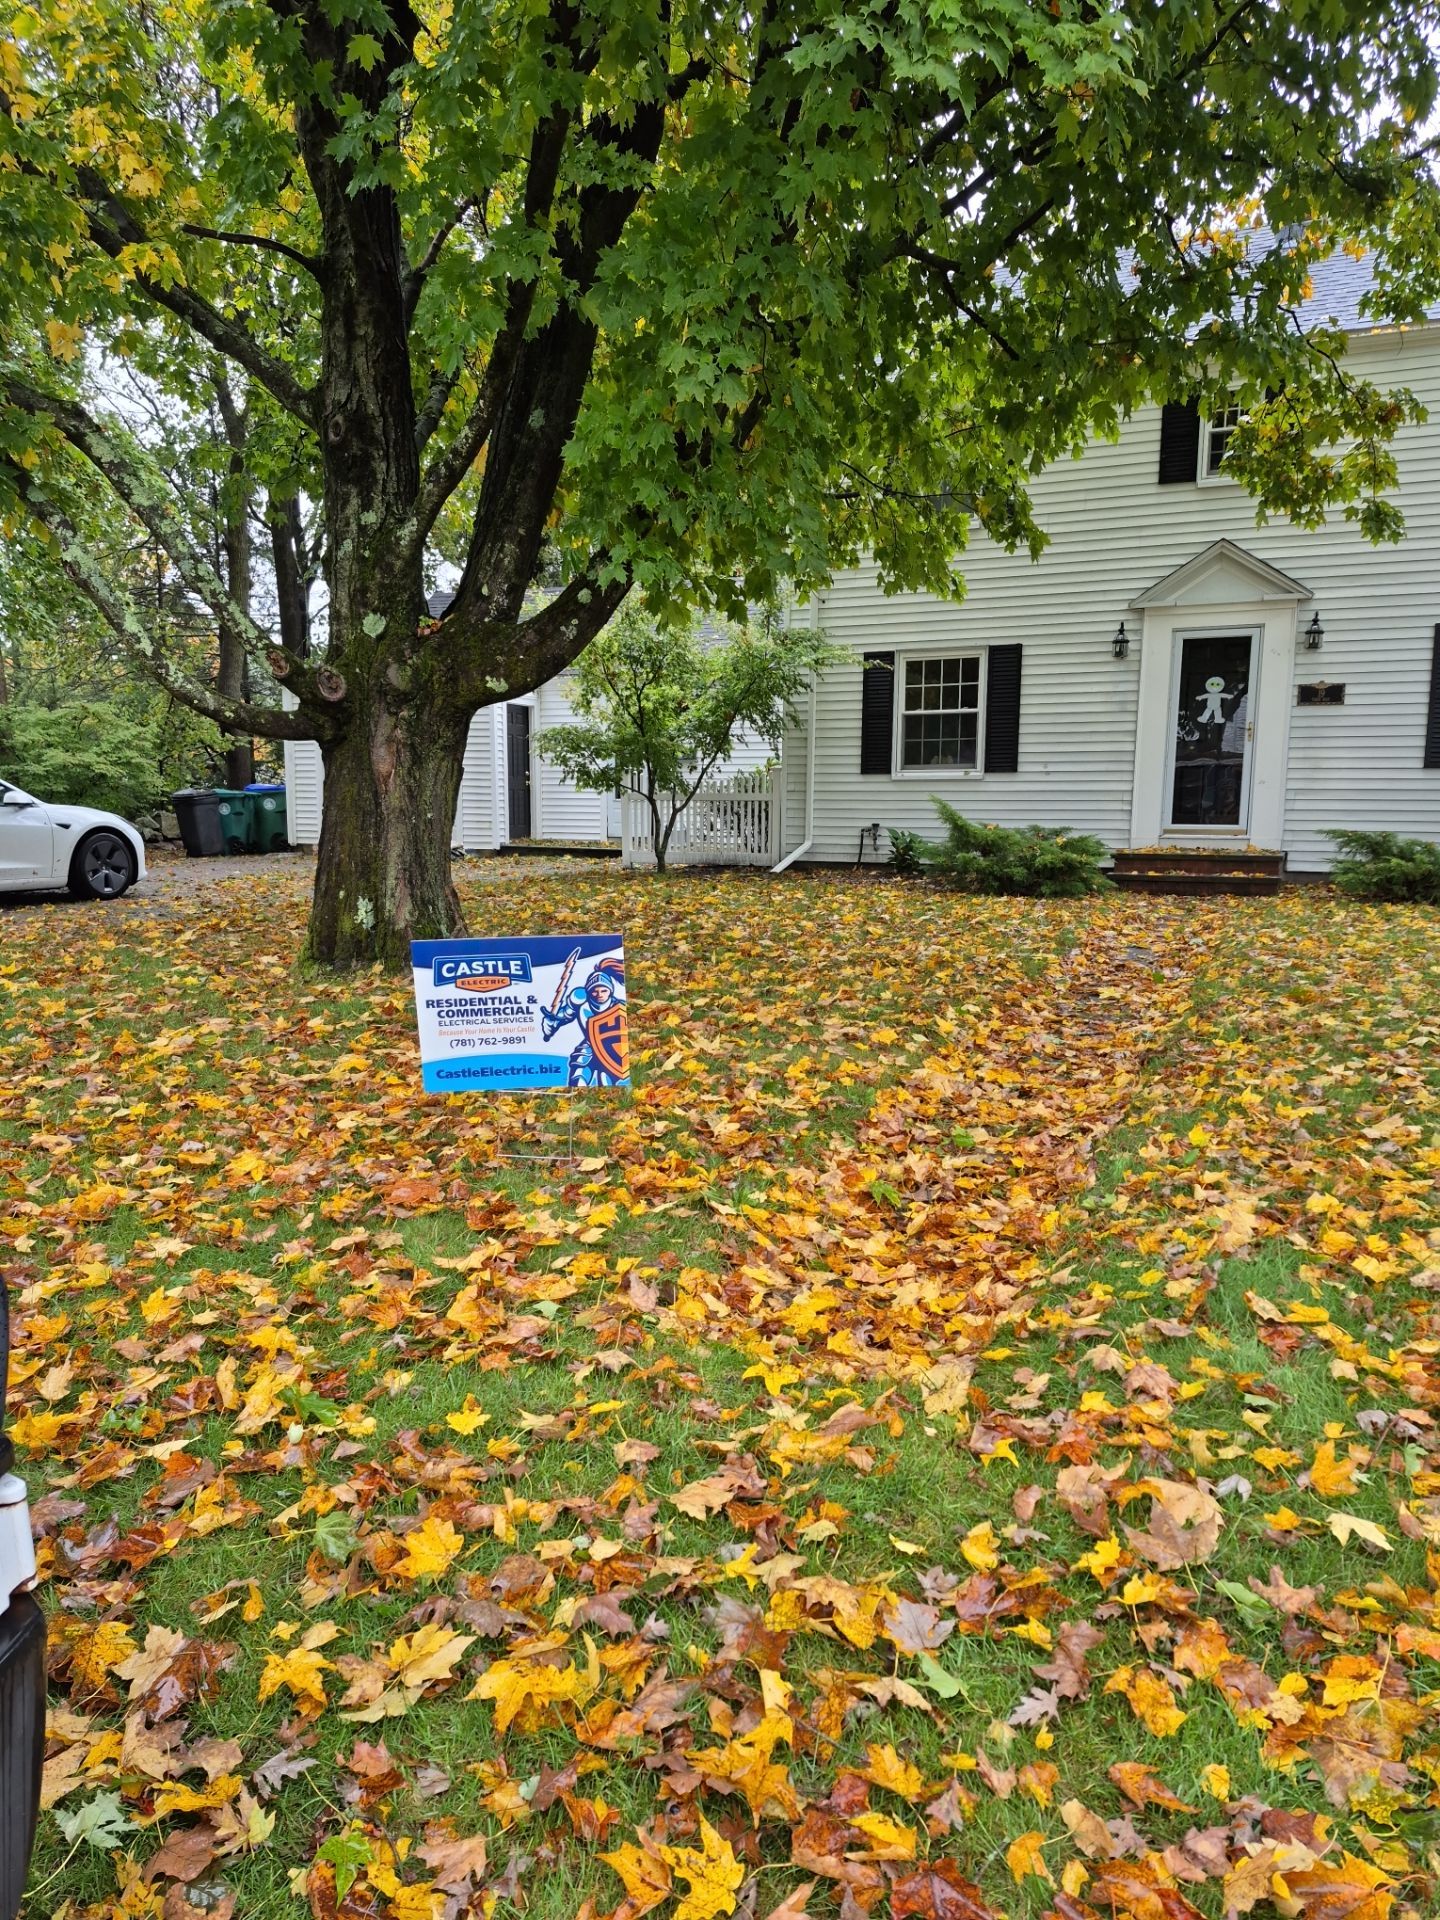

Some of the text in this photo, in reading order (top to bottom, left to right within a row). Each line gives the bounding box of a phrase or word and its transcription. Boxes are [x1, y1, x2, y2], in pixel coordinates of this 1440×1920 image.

[441, 960, 524, 978] CASTLE
[460, 978, 507, 986] ELECTRIC
[425, 995, 538, 1009] RESIDENTIAL &
[437, 1006, 534, 1019] COMMERCIAL
[438, 1016, 534, 1027] ELECTRICAL SERVICES
[464, 1028, 478, 1036] Your
[479, 1027, 496, 1035] Home
[503, 1026, 516, 1034] Your
[517, 1026, 536, 1034] Castle
[449, 1036, 526, 1048] (781) 762-9891
[436, 1064, 562, 1080] CastleElectric.biz
